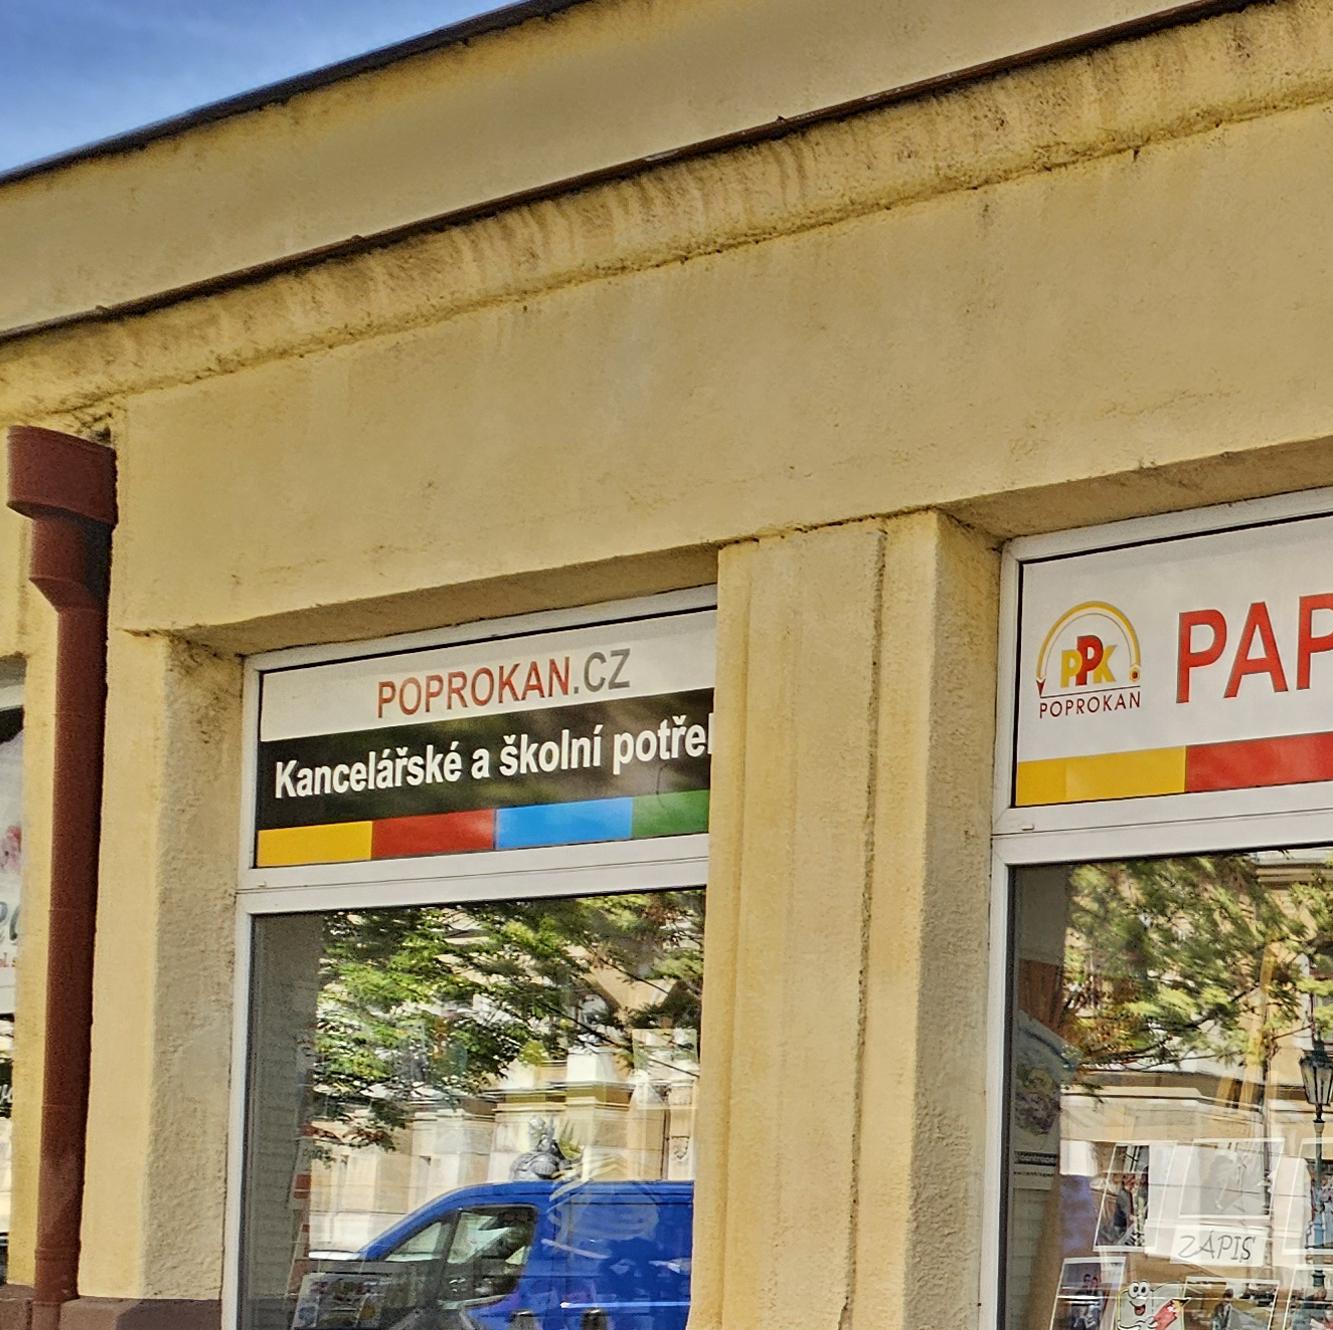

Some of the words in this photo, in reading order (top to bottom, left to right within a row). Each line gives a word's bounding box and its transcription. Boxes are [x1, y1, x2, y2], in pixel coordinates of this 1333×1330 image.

[377, 648, 631, 718] POPROKAN.CZ
[1039, 691, 1141, 719] POPROKAN
[275, 741, 462, 799] Kancelářské
[471, 748, 490, 779] a
[499, 724, 604, 777] školní
[613, 714, 712, 775] potře
